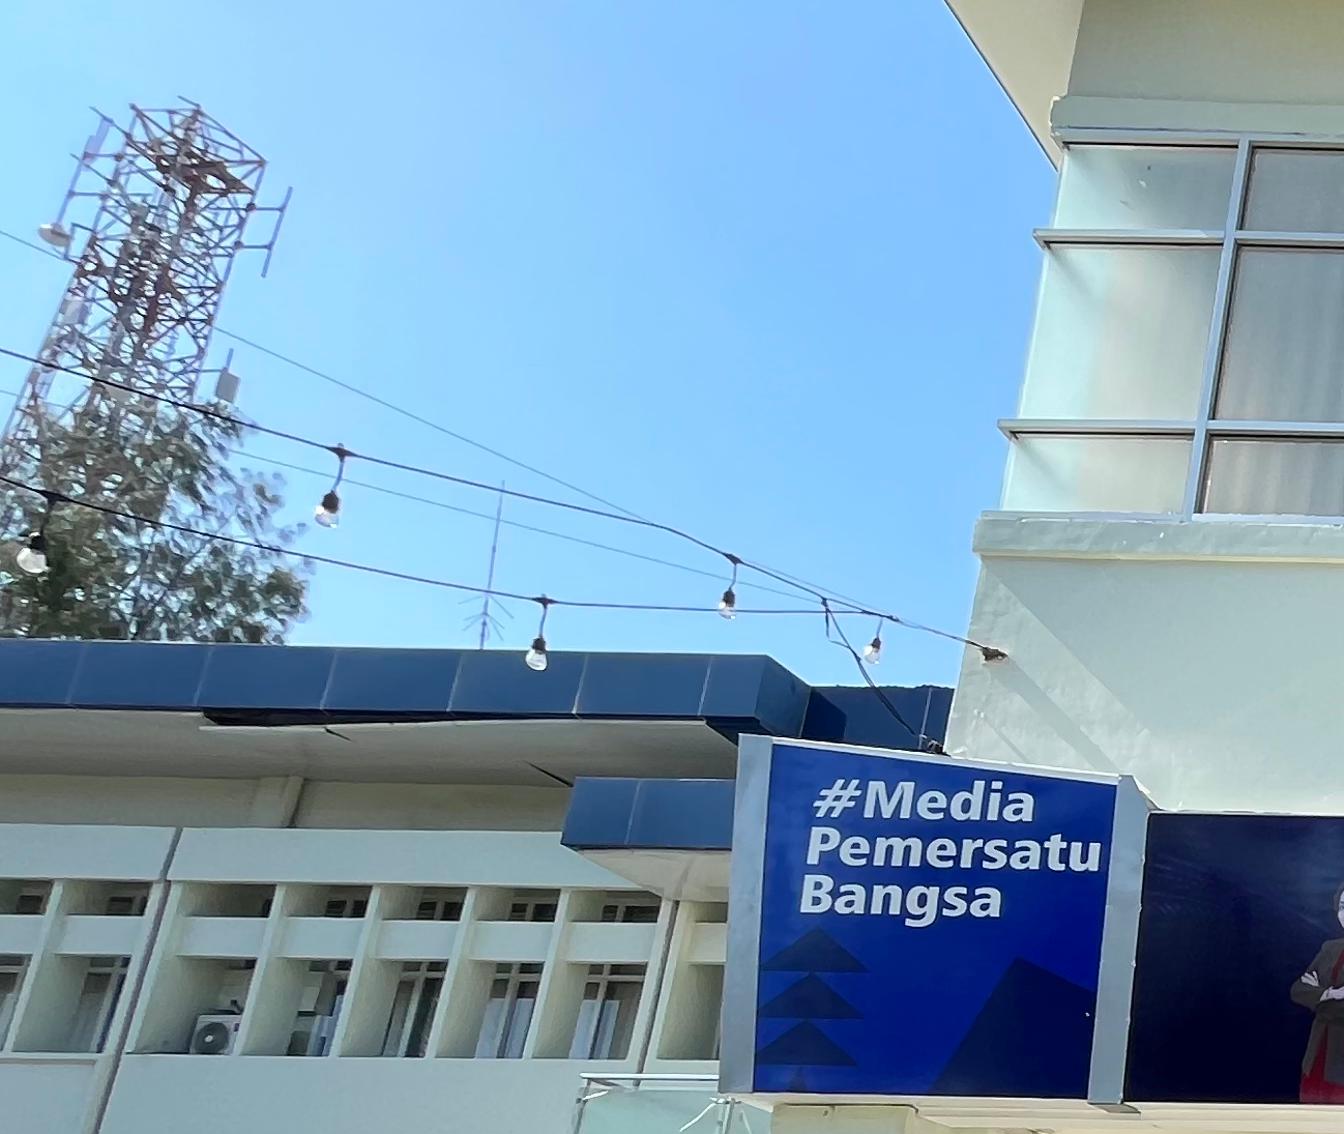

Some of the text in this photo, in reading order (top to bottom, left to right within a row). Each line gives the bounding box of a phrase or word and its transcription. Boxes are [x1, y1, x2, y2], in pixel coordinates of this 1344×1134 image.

[812, 778, 1035, 822] #Media
[806, 826, 1102, 872] Pemersatu
[799, 874, 1002, 928] Bangsa
